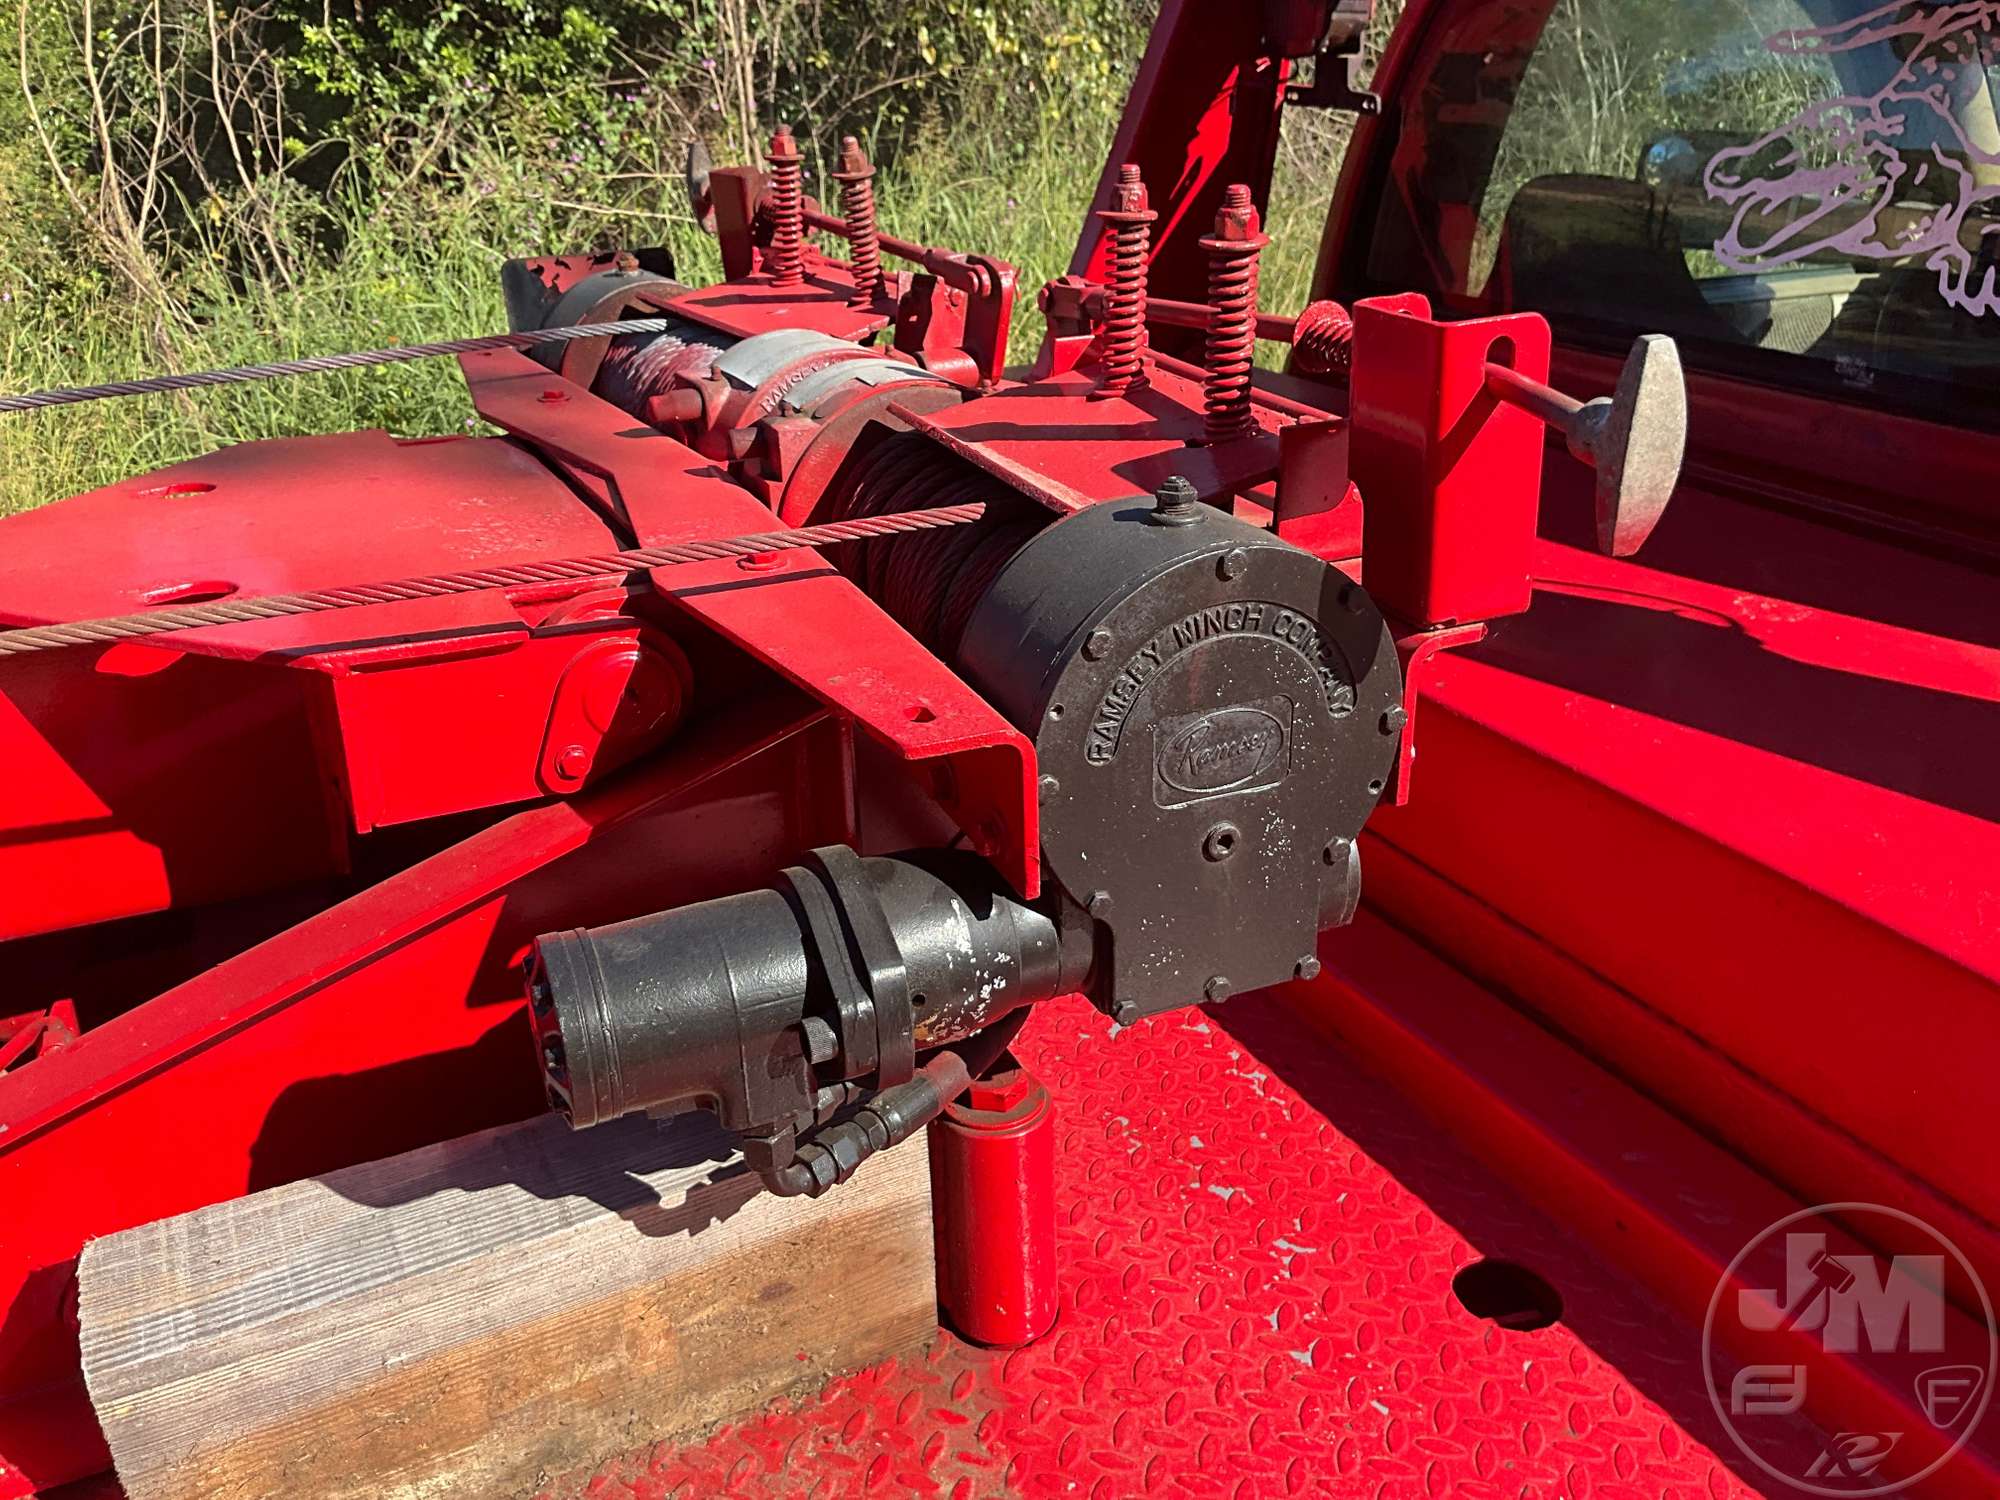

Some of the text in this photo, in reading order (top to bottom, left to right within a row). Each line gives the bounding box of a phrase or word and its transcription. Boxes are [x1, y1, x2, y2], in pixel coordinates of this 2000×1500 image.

[1087, 639, 1162, 760] RAMSEY
[1172, 604, 1263, 649] WINCH
[1174, 723, 1275, 776] Ramsey
